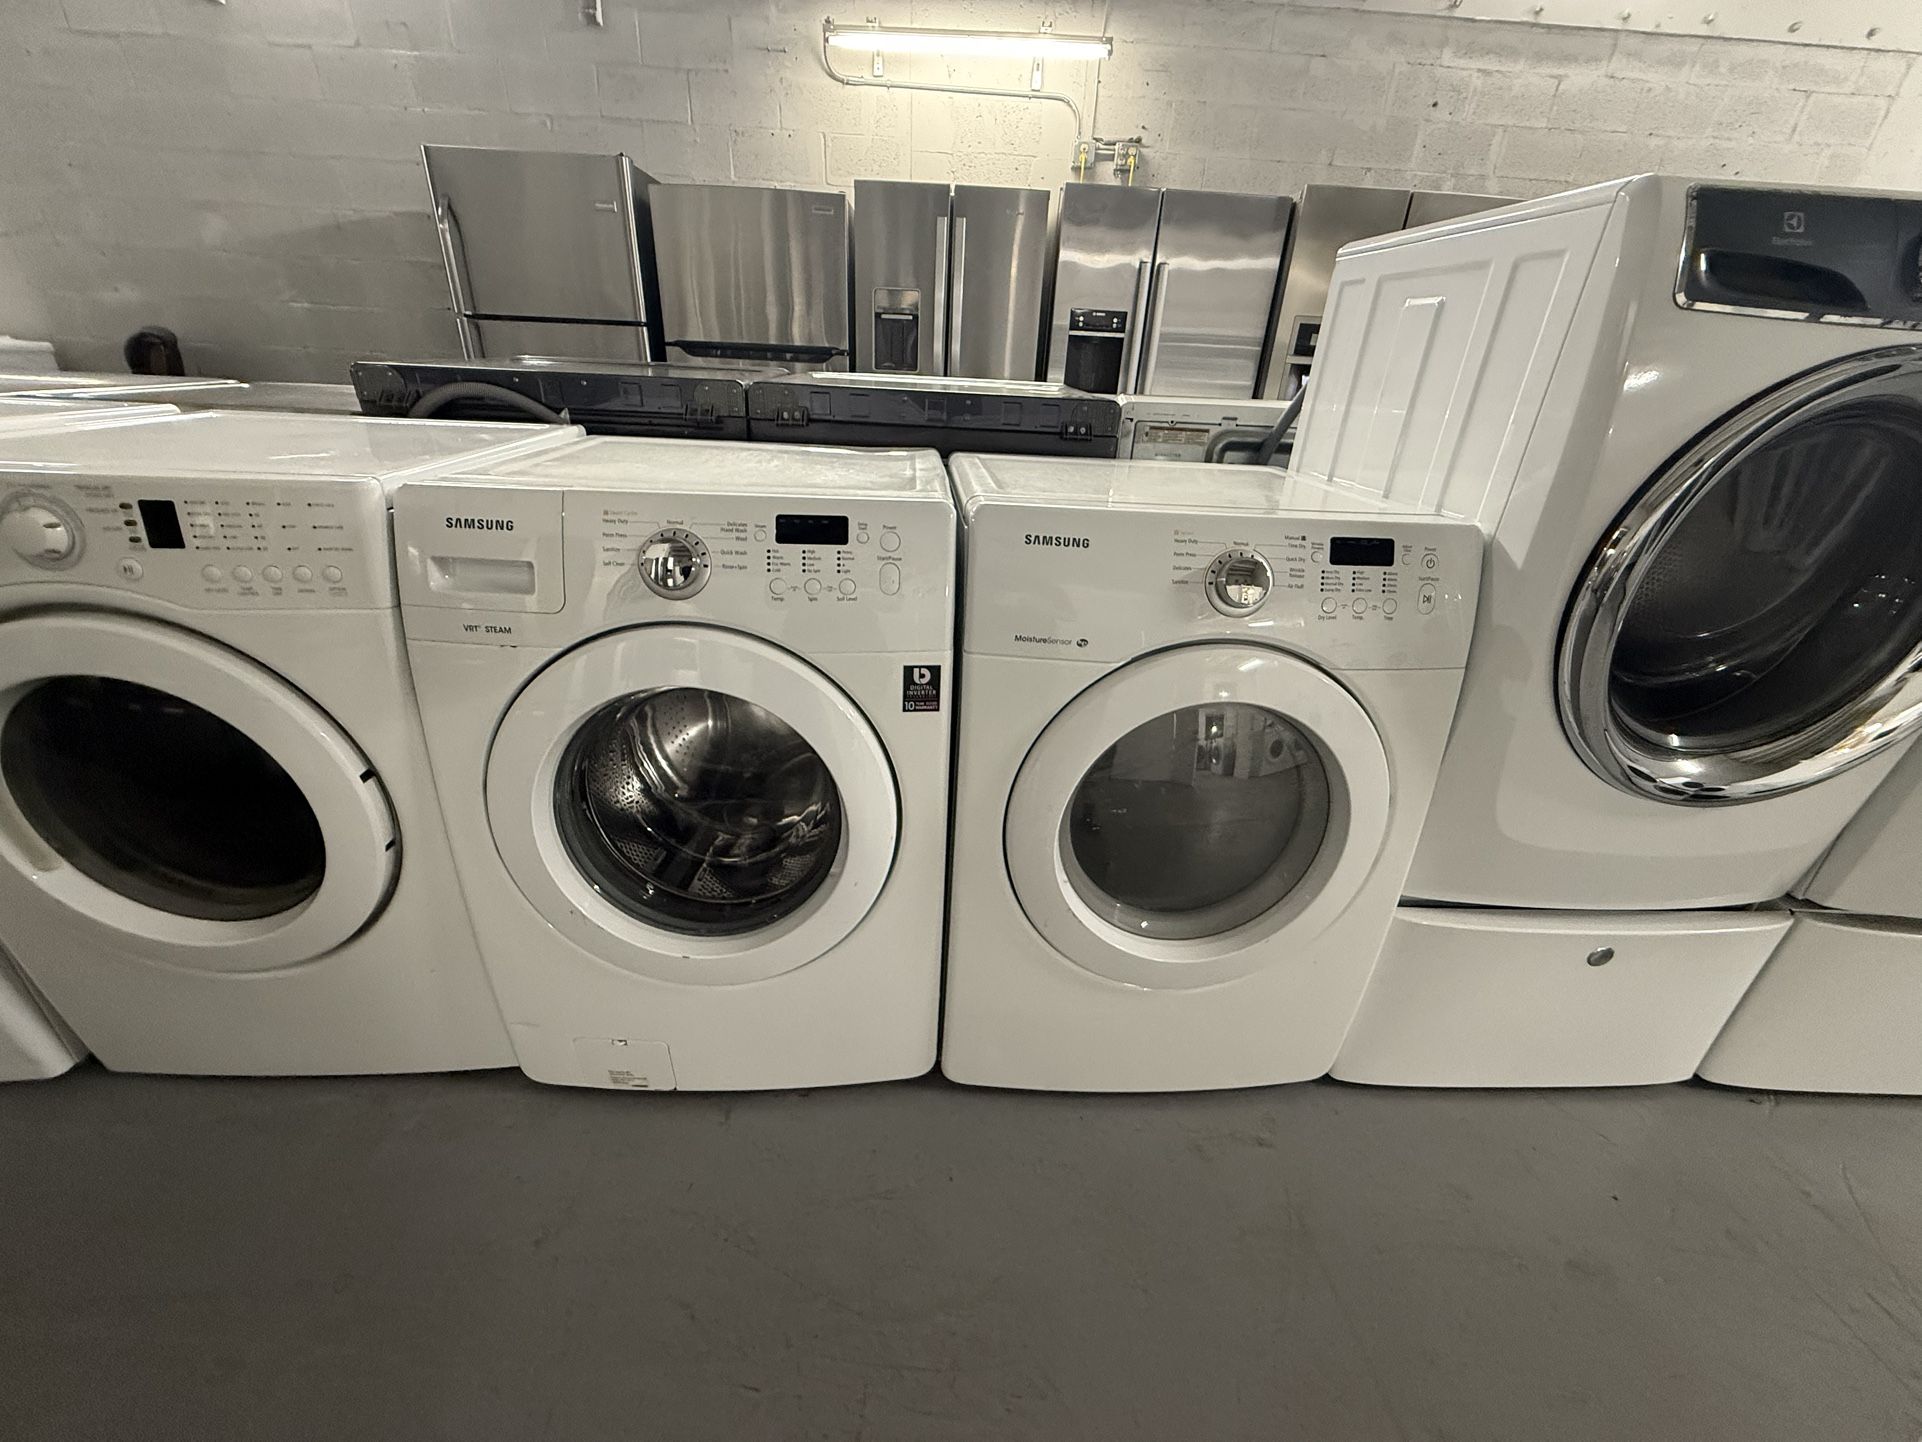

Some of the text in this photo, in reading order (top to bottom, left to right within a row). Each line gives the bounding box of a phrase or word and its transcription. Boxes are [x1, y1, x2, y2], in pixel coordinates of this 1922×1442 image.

[445, 517, 514, 531] SAMSUNG
[1024, 534, 1090, 549] SAMSUNG
[484, 625, 512, 635] STEAM
[1014, 634, 1073, 646] MoistureSensor
[904, 701, 915, 711] 10
